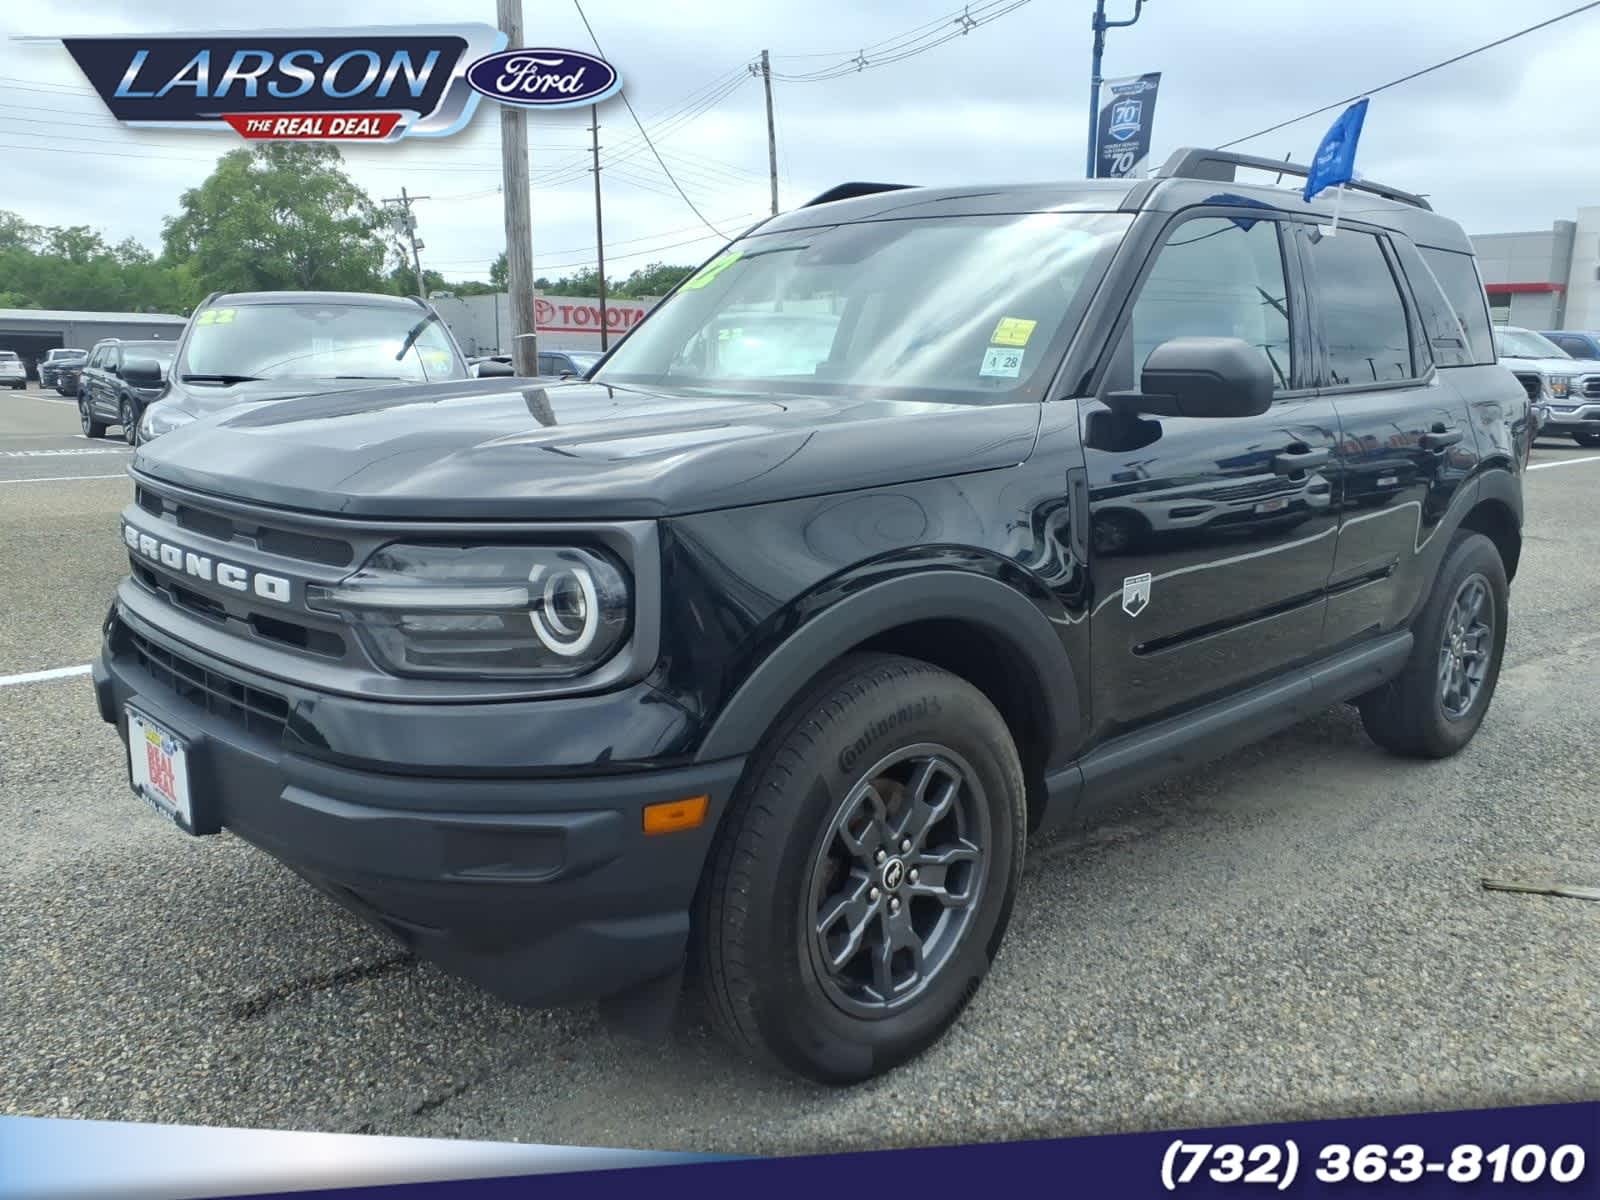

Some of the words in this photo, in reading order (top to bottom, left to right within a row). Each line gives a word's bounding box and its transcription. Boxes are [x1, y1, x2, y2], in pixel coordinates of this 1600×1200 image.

[1003, 356, 1018, 368] 28
[124, 524, 291, 604] BRONCO
[837, 696, 928, 774] Continental
